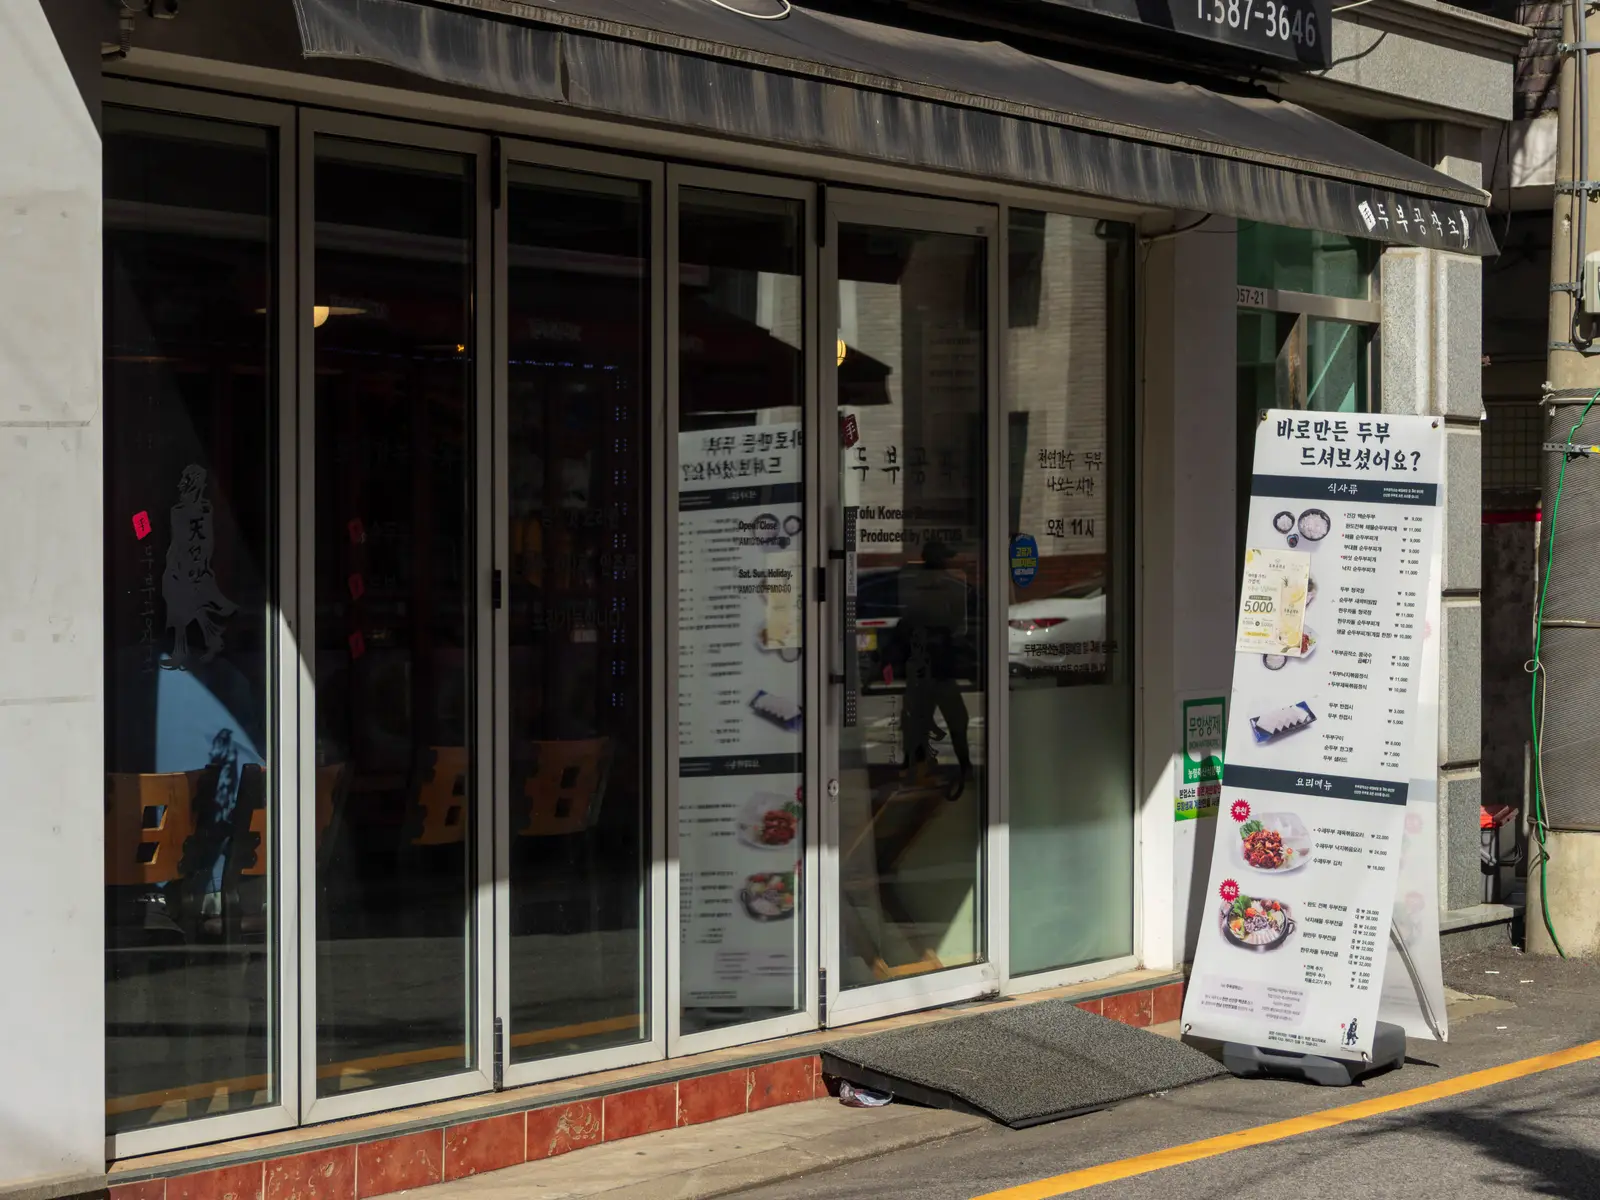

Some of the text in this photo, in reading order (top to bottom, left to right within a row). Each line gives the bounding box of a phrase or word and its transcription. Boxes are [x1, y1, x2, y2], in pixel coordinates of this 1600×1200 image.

[1277, 418, 1390, 444] 바로만든 두부
[1085, 452, 1103, 470] 두부
[1300, 447, 1421, 472] 드셔보셨어요?
[1328, 484, 1358, 495] 식사류
[861, 529, 909, 542] Produced
[1047, 519, 1095, 538] 오전 11시
[1296, 778, 1332, 791] 요리메뉴
